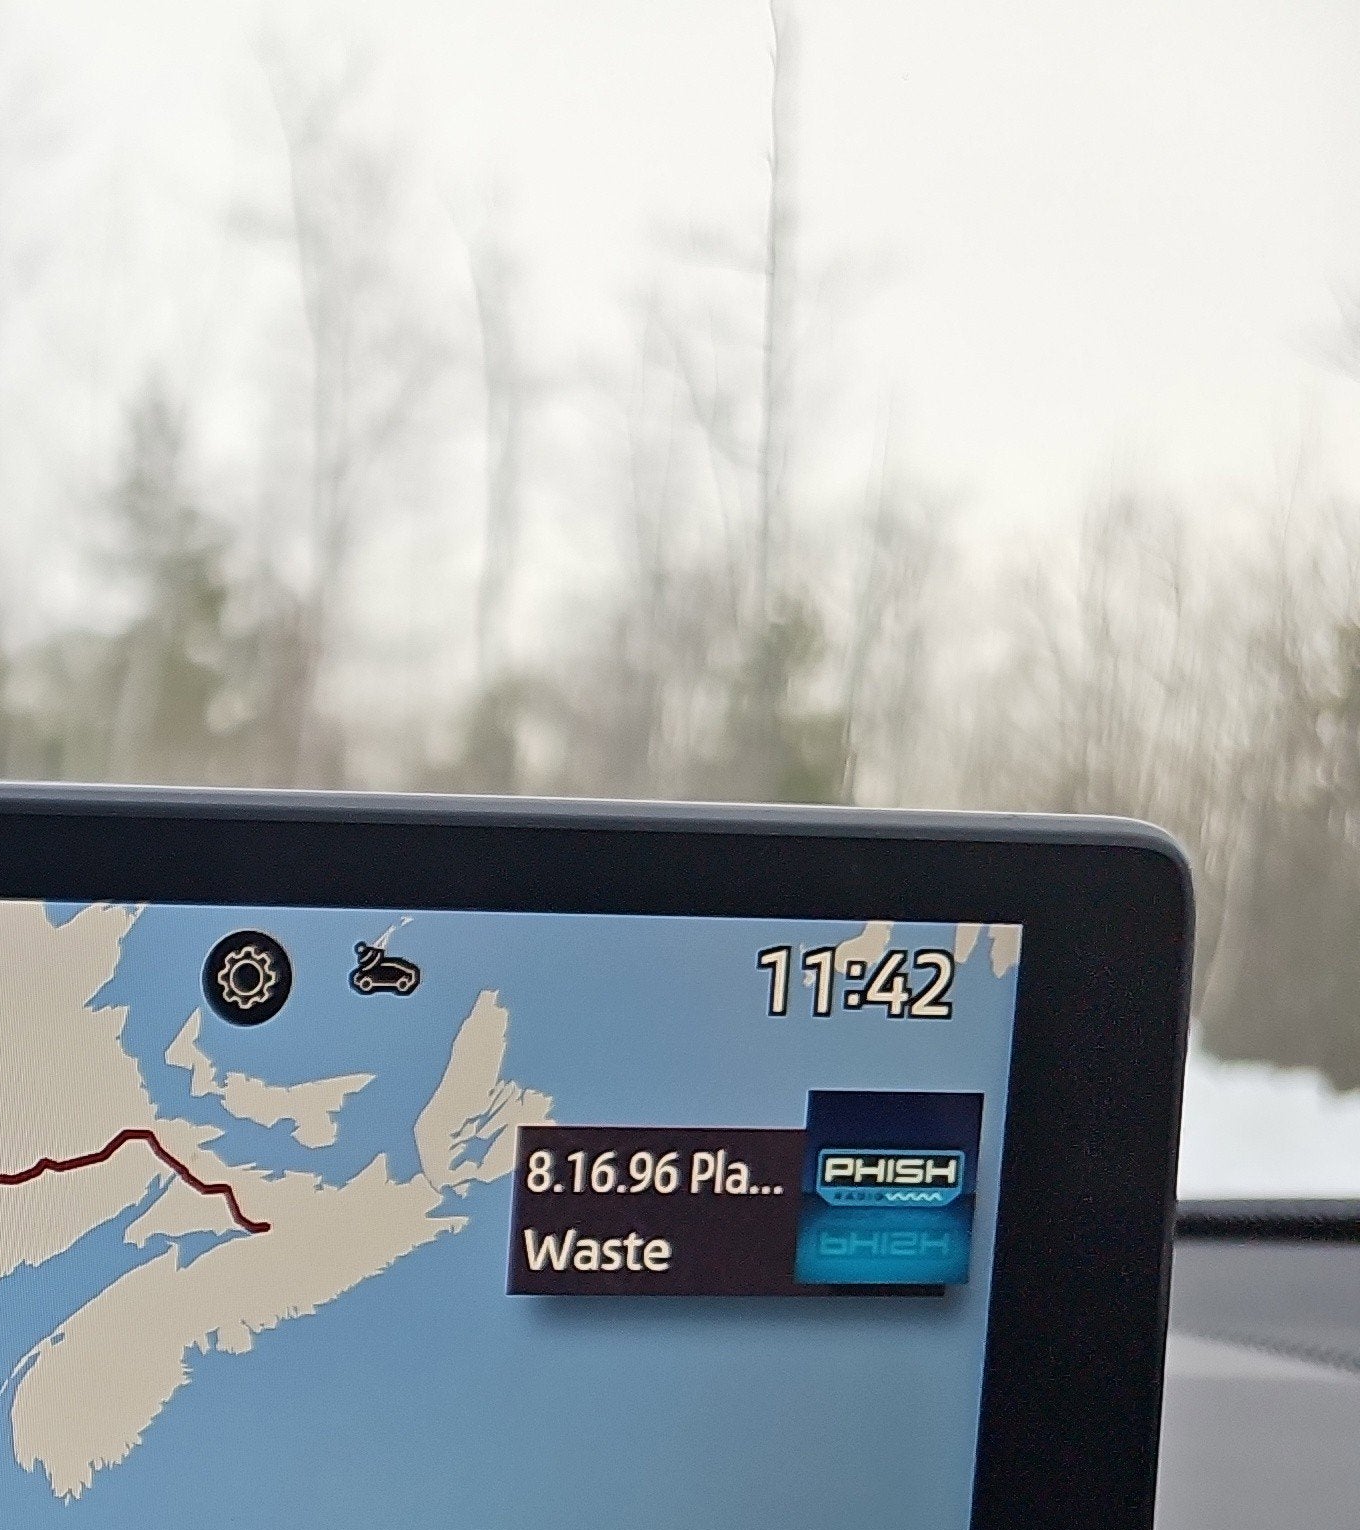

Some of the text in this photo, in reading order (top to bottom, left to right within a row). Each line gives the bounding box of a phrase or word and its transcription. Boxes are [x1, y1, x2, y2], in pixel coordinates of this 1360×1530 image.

[759, 946, 955, 1018] 11:42
[526, 1148, 785, 1196] 8.16.96 Pla...
[824, 1157, 958, 1184] PHISH
[522, 1226, 673, 1273] Waste
